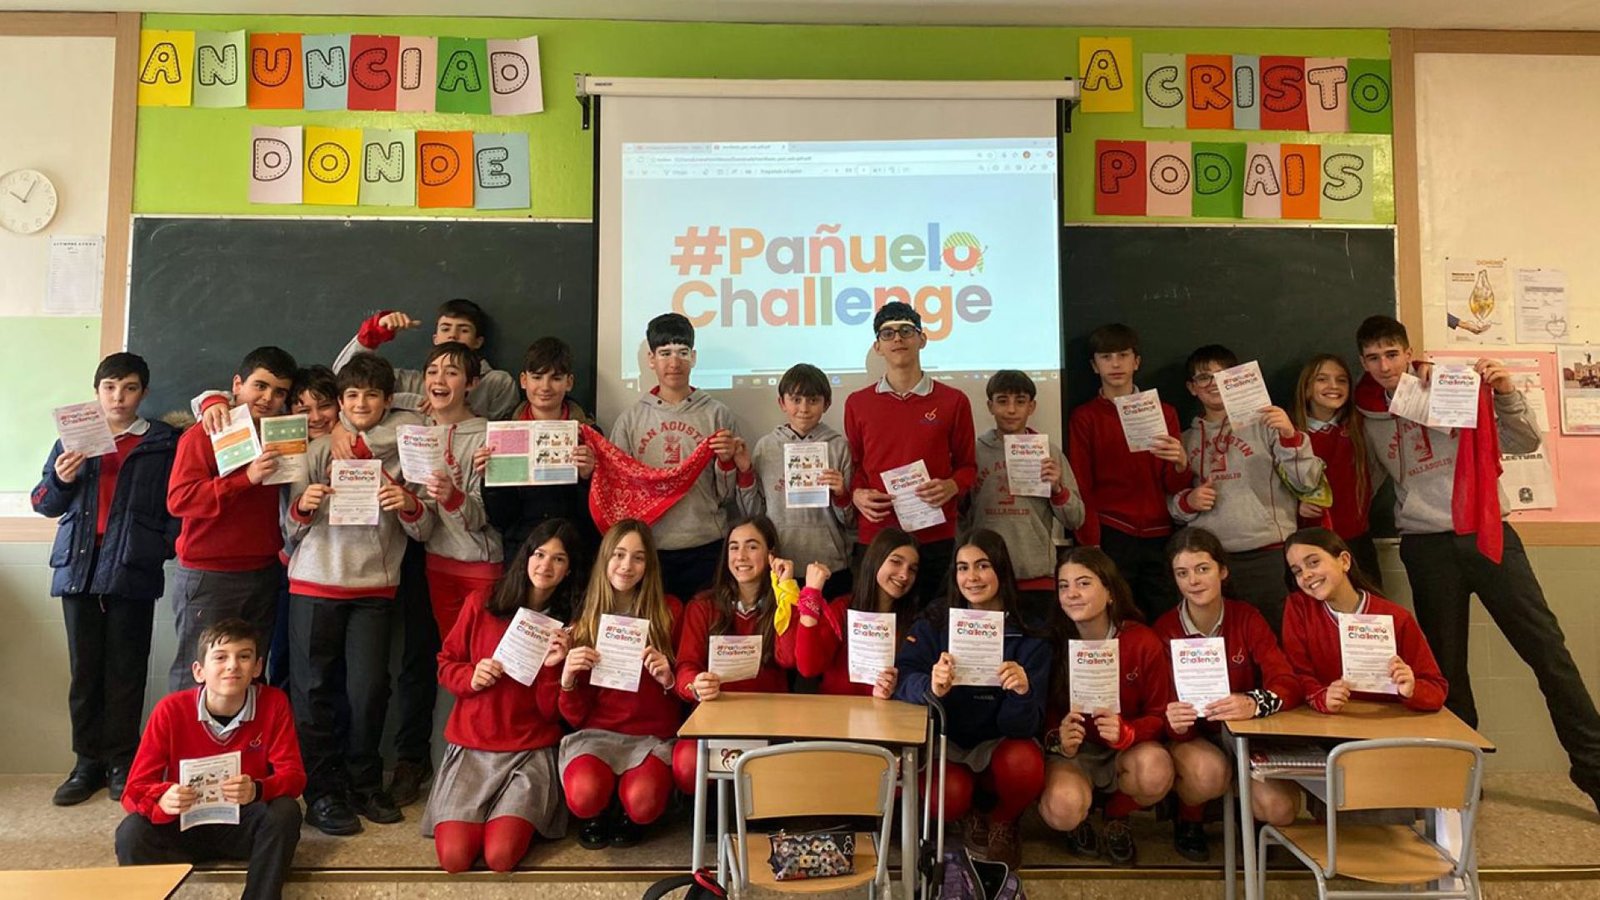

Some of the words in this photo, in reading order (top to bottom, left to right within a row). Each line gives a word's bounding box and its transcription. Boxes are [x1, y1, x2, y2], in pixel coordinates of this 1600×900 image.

[140, 42, 529, 94] ANUNCIAD
[1083, 49, 1123, 91] A
[1145, 64, 1390, 113] CRISTO
[253, 137, 512, 188] DONDE
[1099, 149, 1364, 201] PODAIS
[670, 222, 984, 275] #Pañuelo
[671, 276, 993, 341] Challenge
[957, 627, 998, 639] Challenge
[1348, 632, 1389, 643] Challenge
